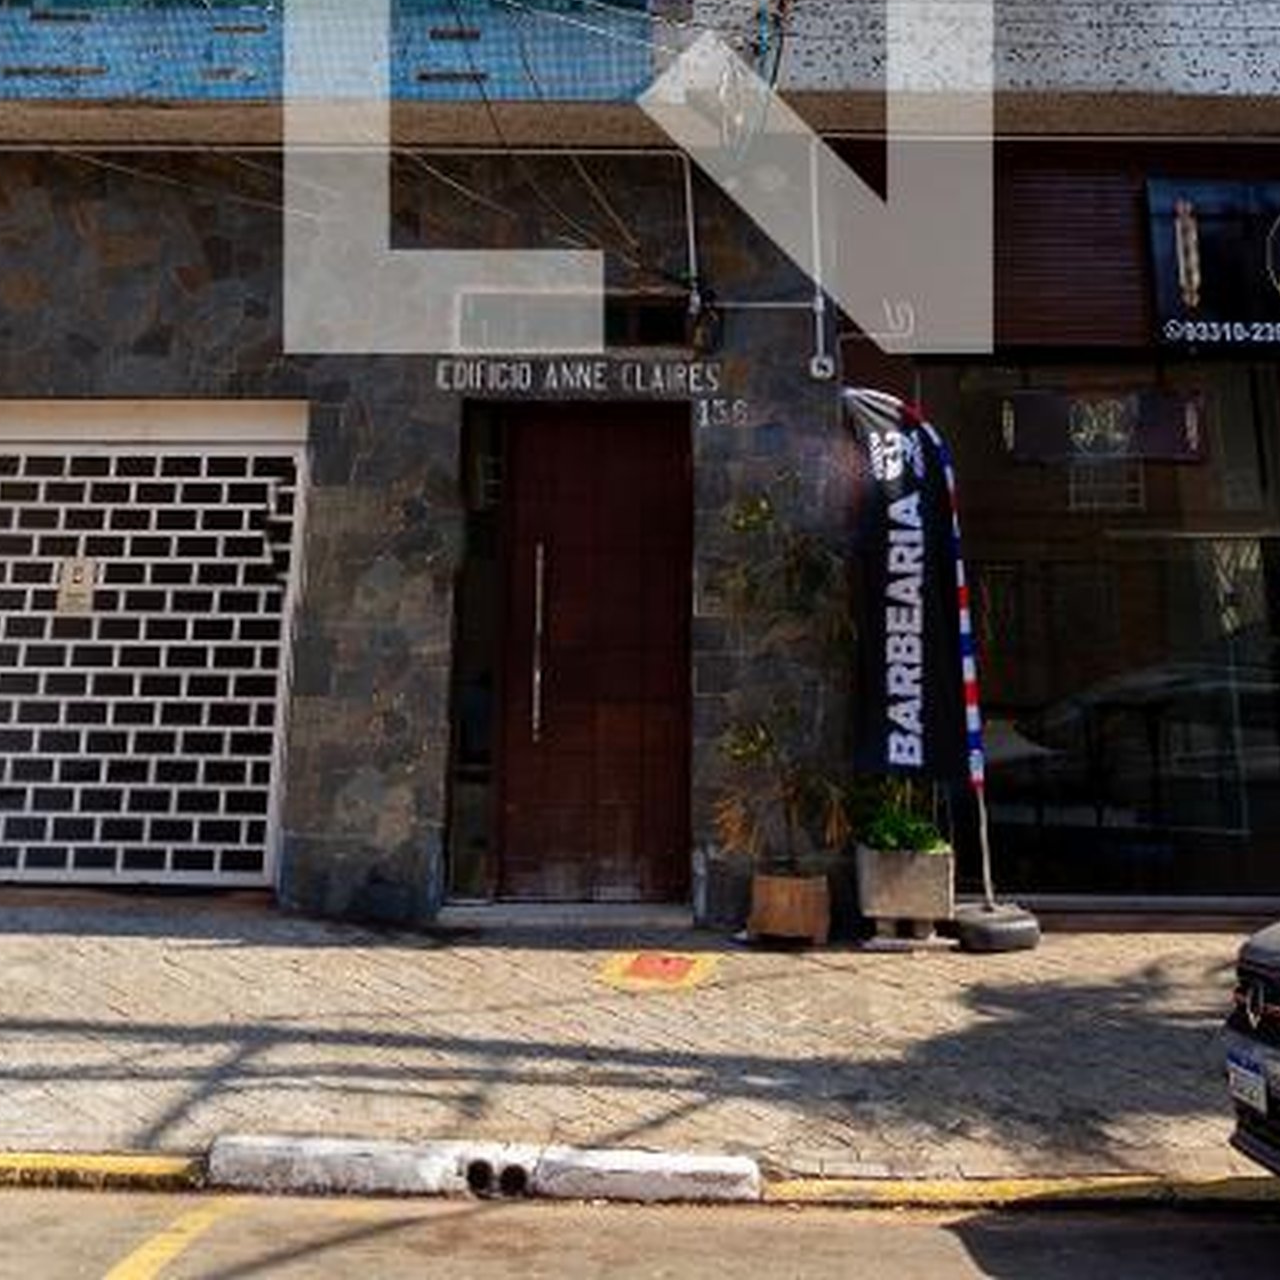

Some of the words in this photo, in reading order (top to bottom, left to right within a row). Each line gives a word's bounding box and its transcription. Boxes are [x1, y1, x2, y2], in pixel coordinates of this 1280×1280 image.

[545, 361, 608, 391] ANNE
[621, 362, 721, 393] CLAIRES
[885, 489, 926, 767] BARBEARIA
